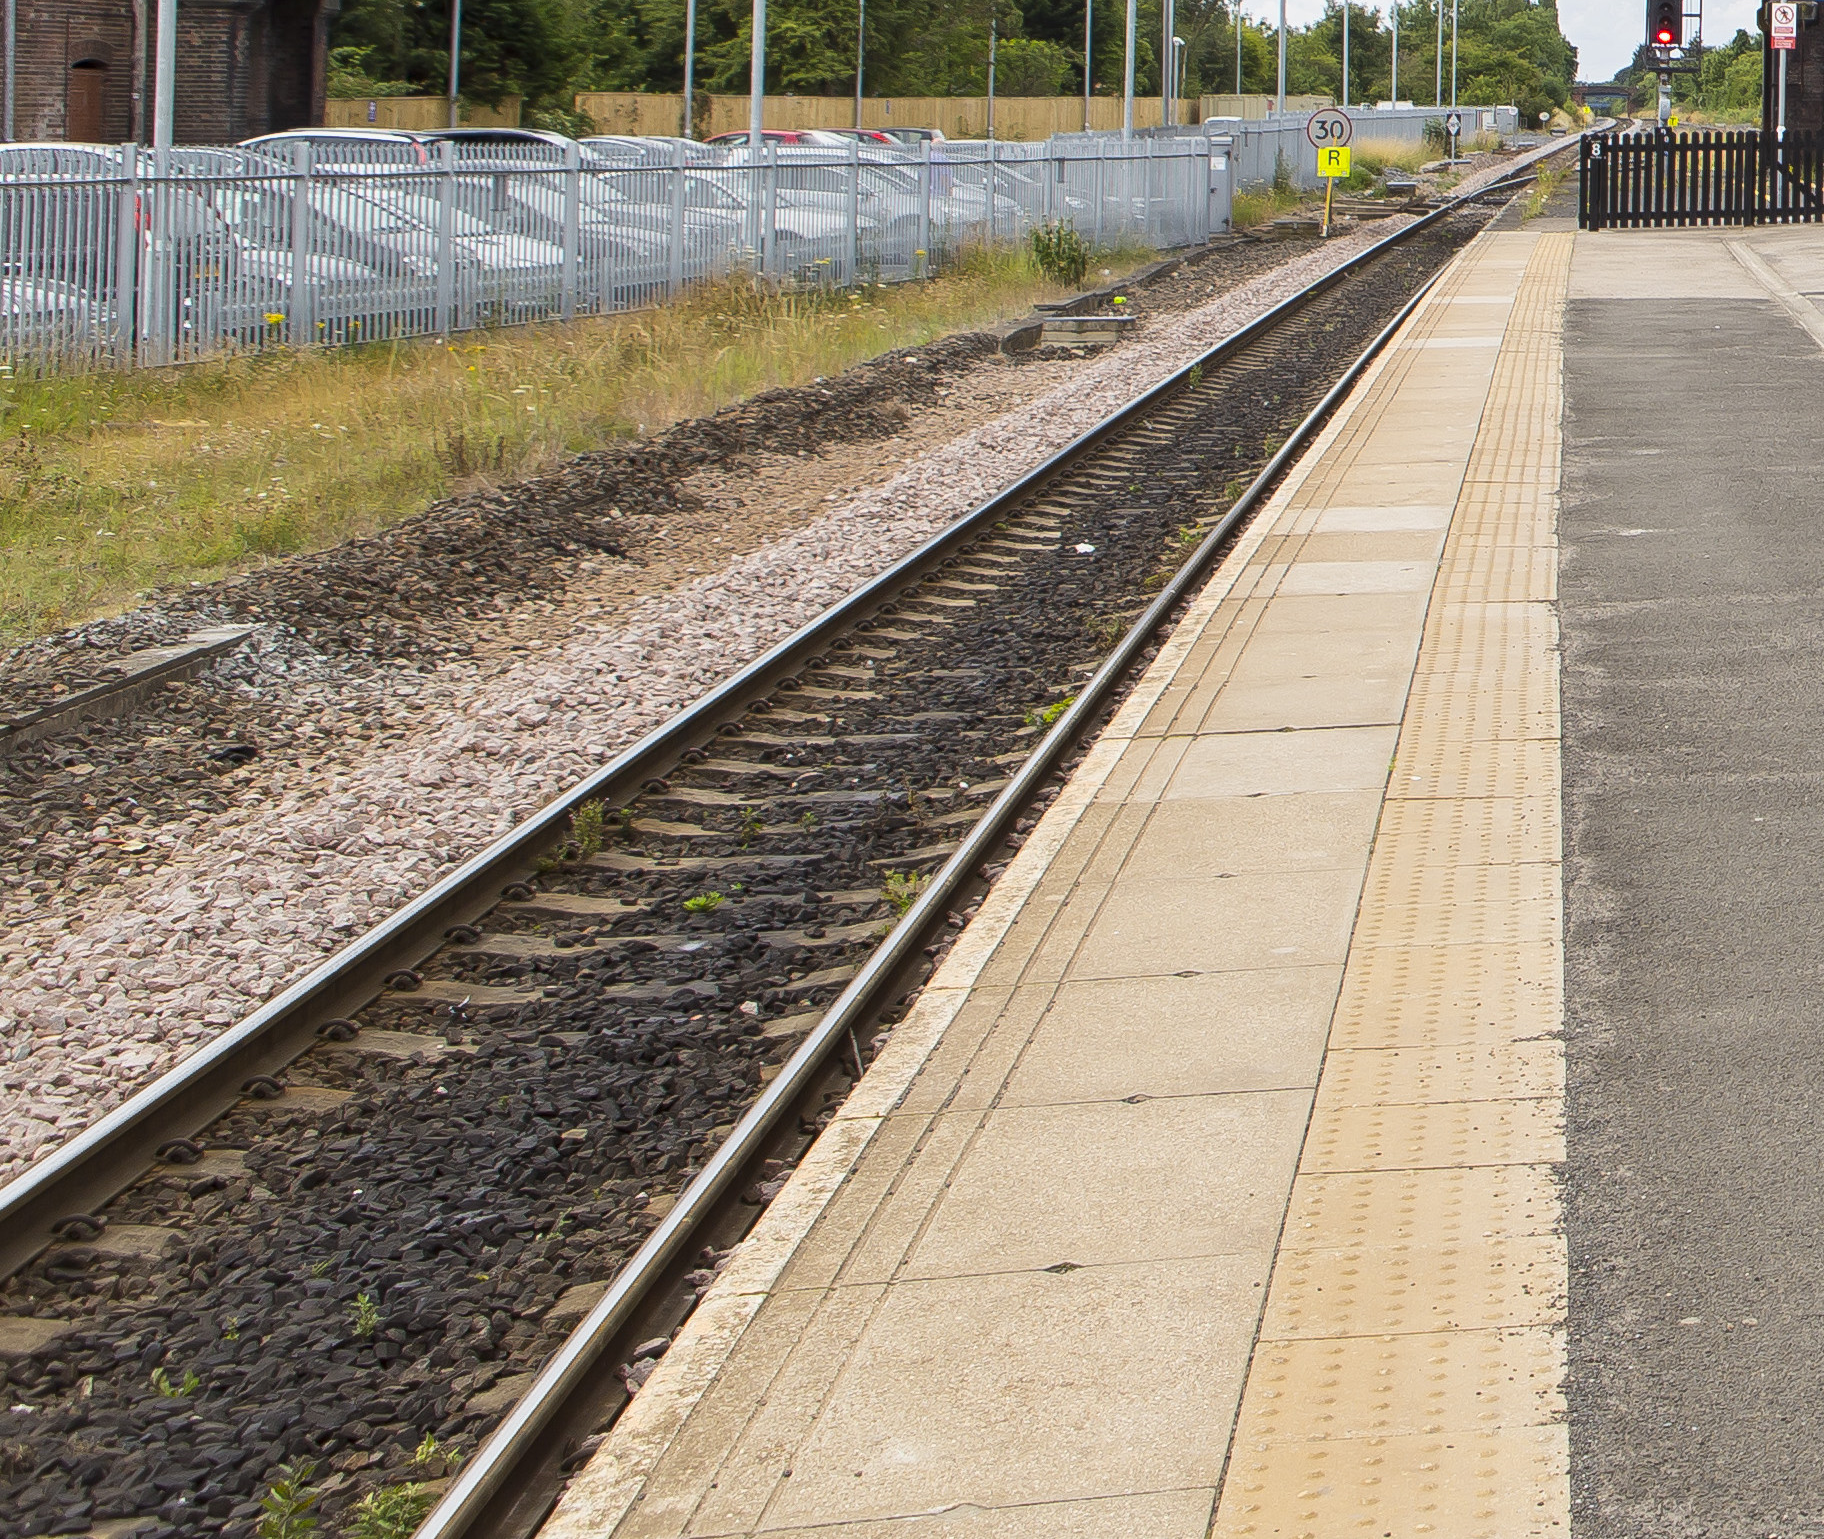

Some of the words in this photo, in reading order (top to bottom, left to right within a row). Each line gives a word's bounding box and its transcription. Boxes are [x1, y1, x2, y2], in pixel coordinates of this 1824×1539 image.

[1315, 119, 1344, 140] 30
[1328, 149, 1340, 166] R
[1591, 142, 1601, 156] 8
